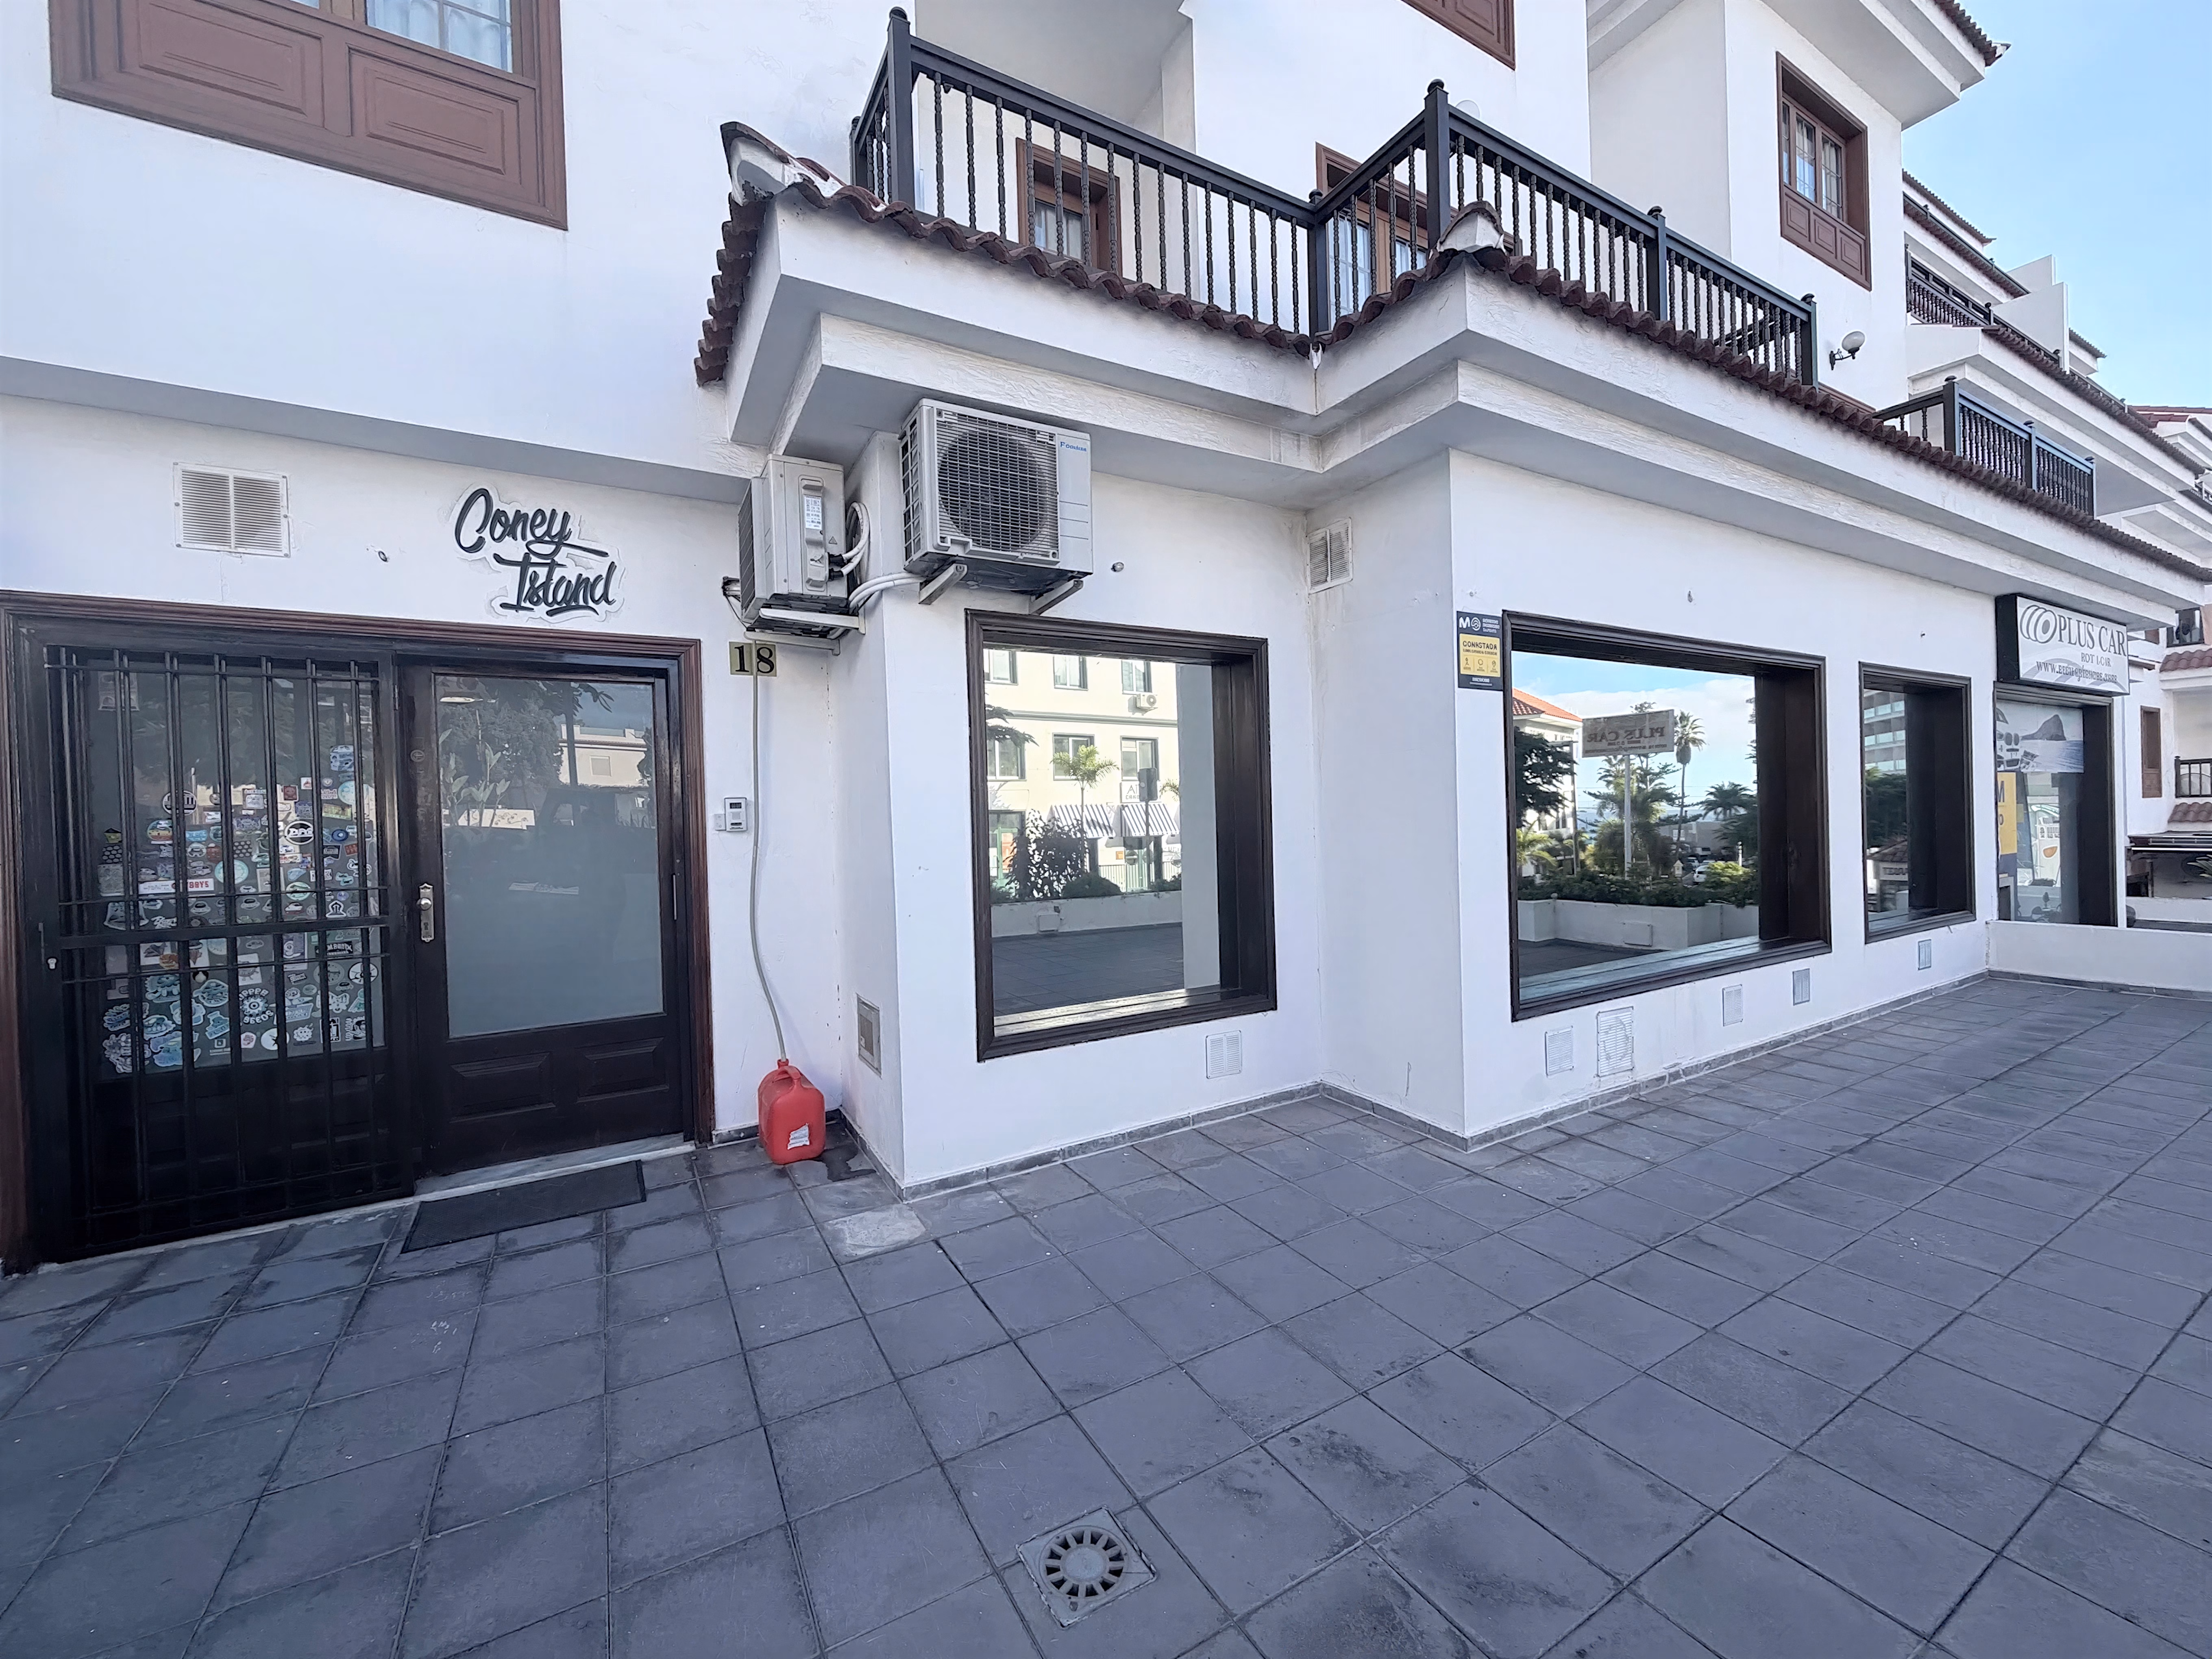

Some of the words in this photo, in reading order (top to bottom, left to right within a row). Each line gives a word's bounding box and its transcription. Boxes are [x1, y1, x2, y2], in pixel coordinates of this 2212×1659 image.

[455, 488, 609, 560] Coney
[493, 552, 617, 616] Island
[734, 645, 774, 673] 18
[2057, 614, 2095, 649] PLUS
[2099, 626, 2127, 657] CAR
